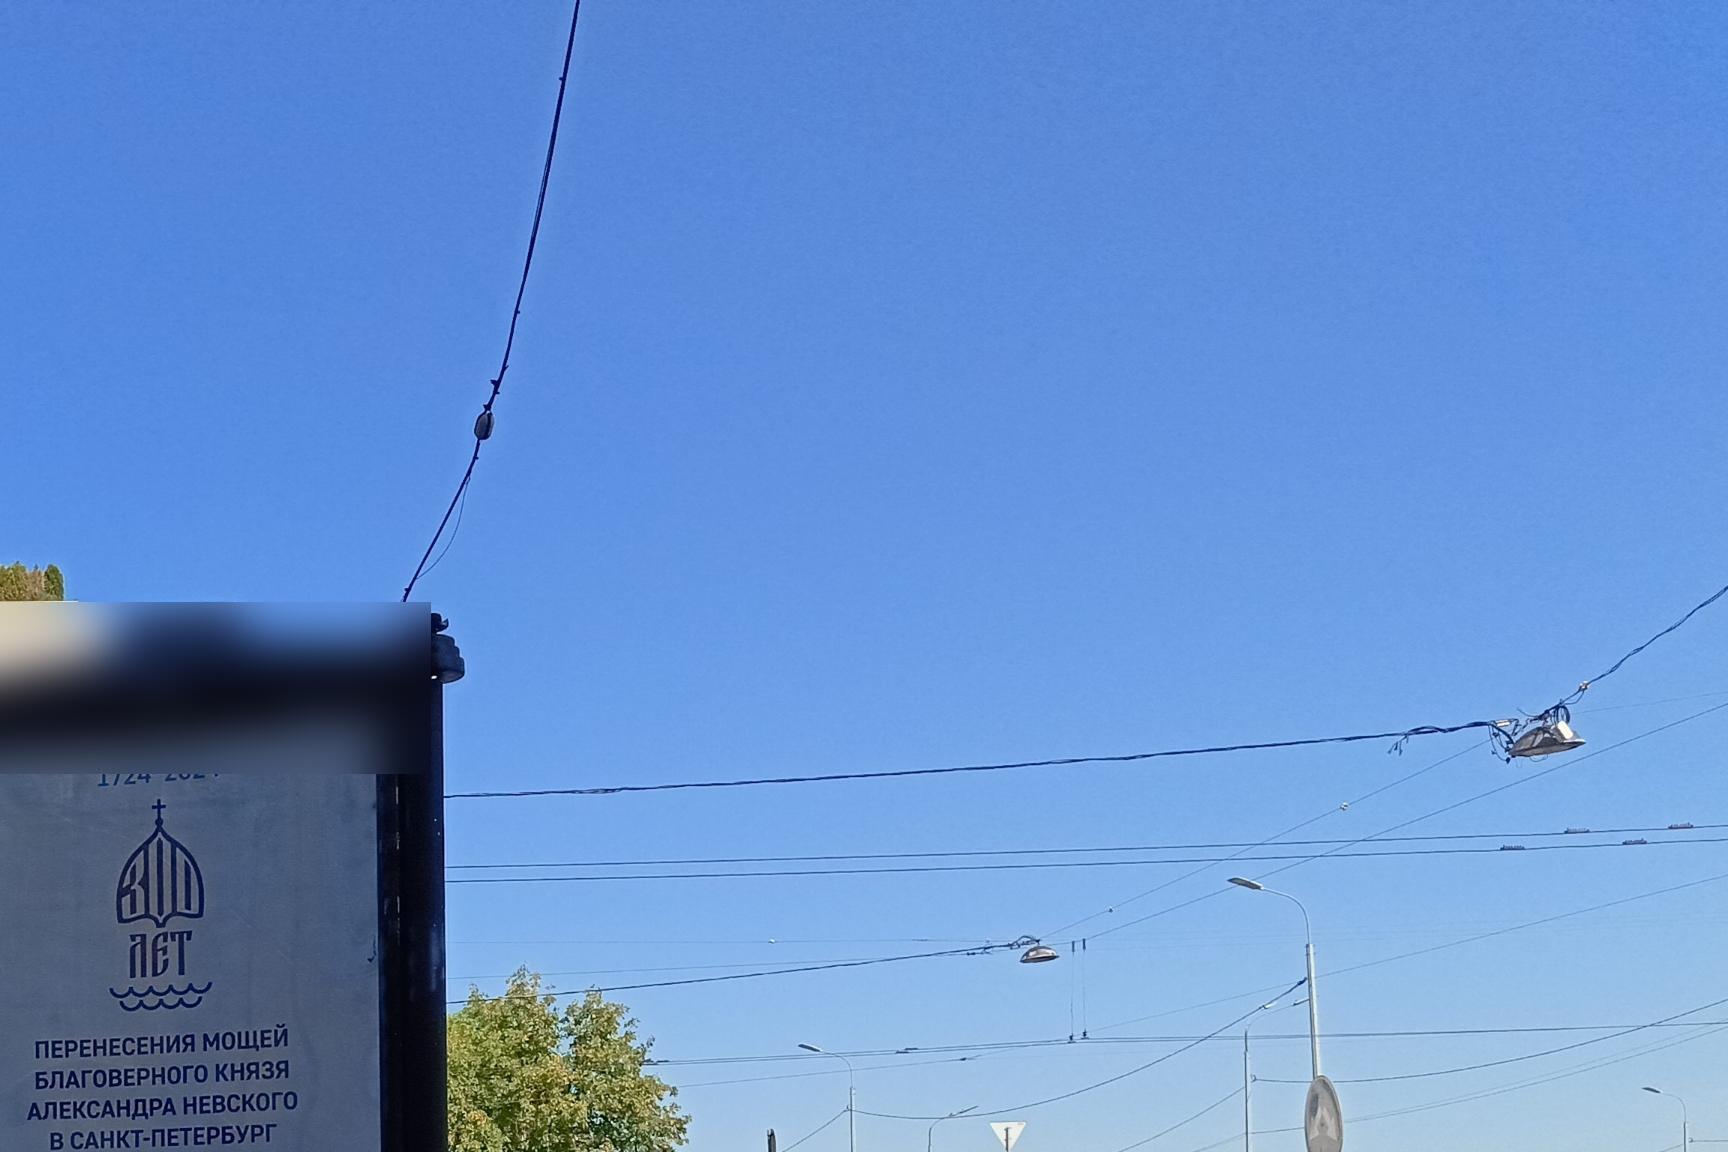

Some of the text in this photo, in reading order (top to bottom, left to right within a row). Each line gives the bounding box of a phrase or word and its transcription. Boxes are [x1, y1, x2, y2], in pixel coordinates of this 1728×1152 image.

[35, 1024, 289, 1059] ПЕРЕНЕСЕНИЯ МОЩЕЙ
[35, 1060, 289, 1090] БЛАГОВЕРНОГО КНЯЗЯ
[27, 1091, 298, 1120] АЛЕКСАНДРА НЕВСКОГО
[49, 1124, 277, 1151] В САНКТ-ПЕТЕРБУРГ
